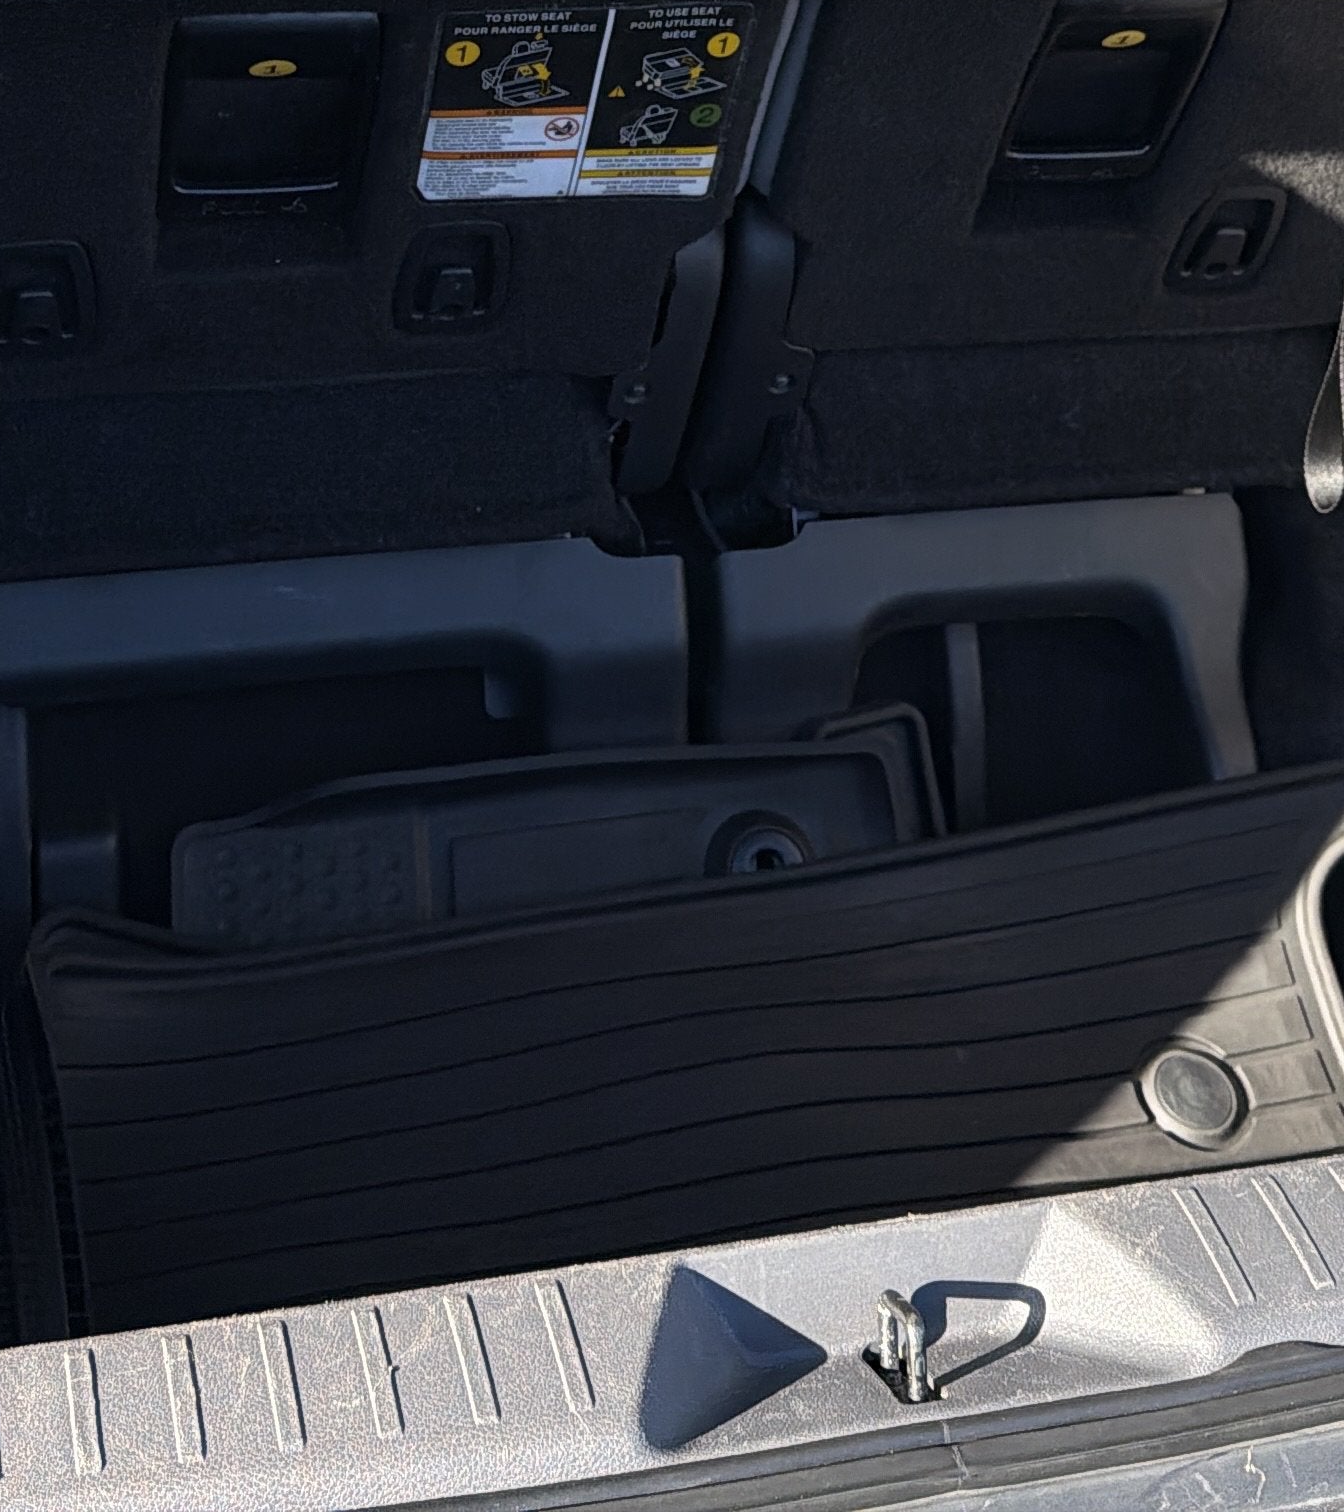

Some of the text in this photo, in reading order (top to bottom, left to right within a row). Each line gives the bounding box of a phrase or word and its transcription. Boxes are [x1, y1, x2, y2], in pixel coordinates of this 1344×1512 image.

[485, 11, 573, 23] TO STOW SEAT
[648, 6, 723, 19] TO USE SEAT
[630, 17, 735, 30] POUR UTILISER LE
[454, 26, 489, 36] POUR
[490, 25, 541, 35] RANGER
[543, 25, 560, 33] LE
[718, 35, 729, 55] 1
[456, 44, 468, 63] 1
[703, 107, 716, 125] 2
